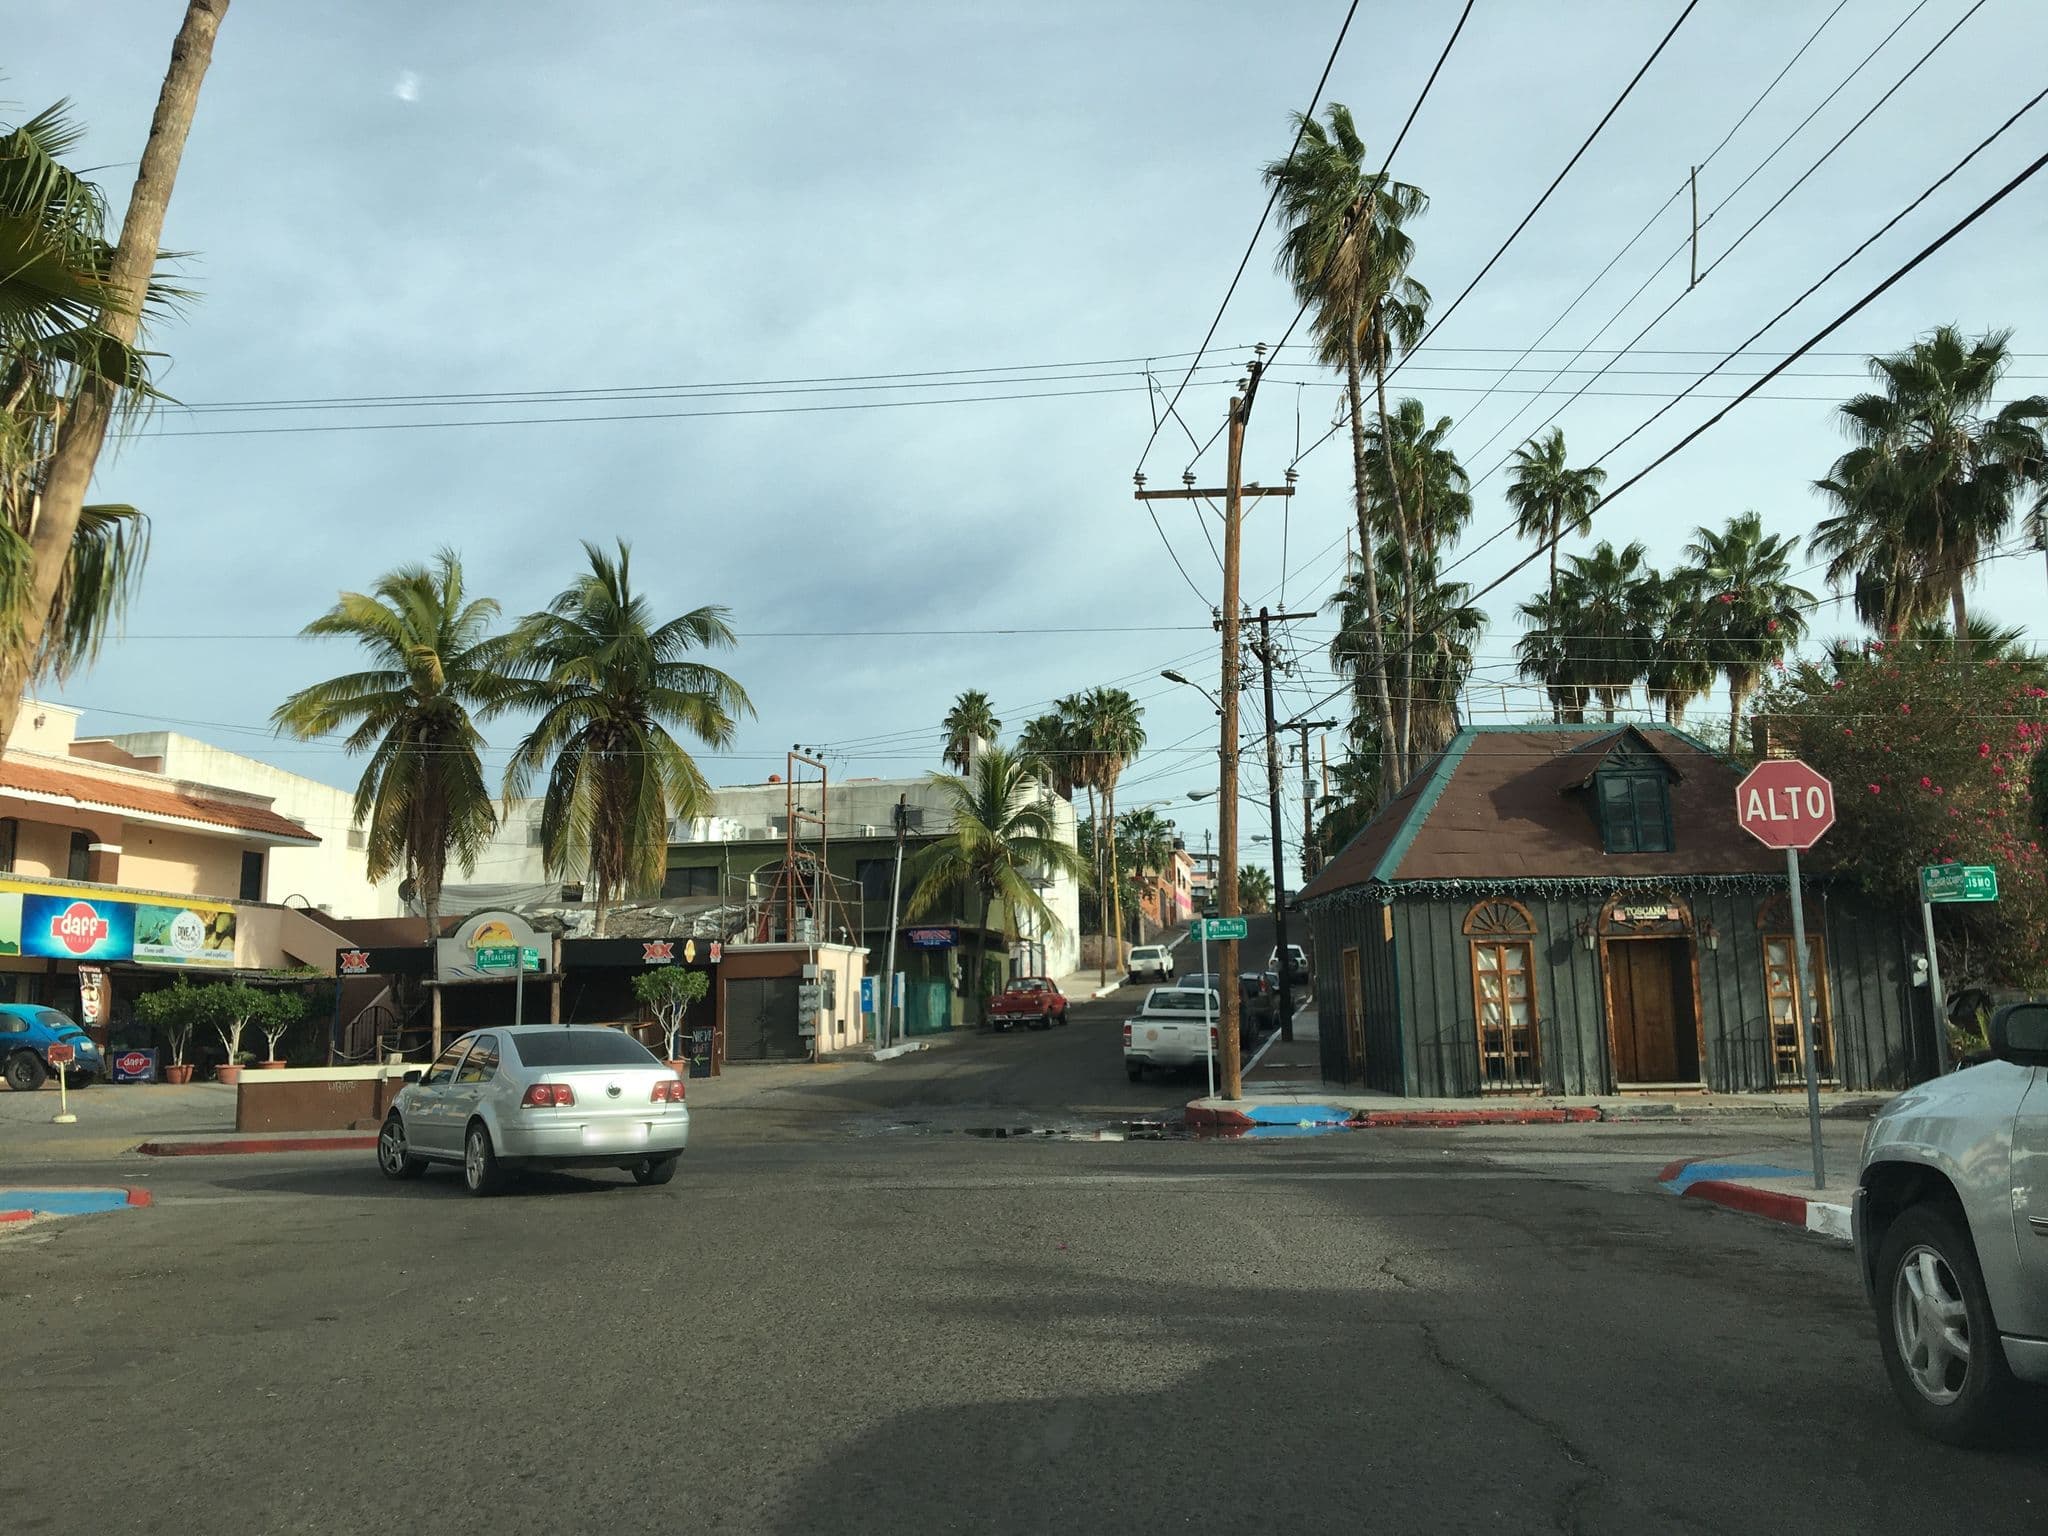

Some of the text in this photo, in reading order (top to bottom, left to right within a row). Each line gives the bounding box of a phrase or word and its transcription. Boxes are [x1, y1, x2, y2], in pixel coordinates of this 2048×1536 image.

[1746, 786, 1825, 822] ALTO
[1966, 878, 1990, 888] ISMO
[1625, 906, 1667, 916] TOSCANA
[61, 913, 98, 936] daff
